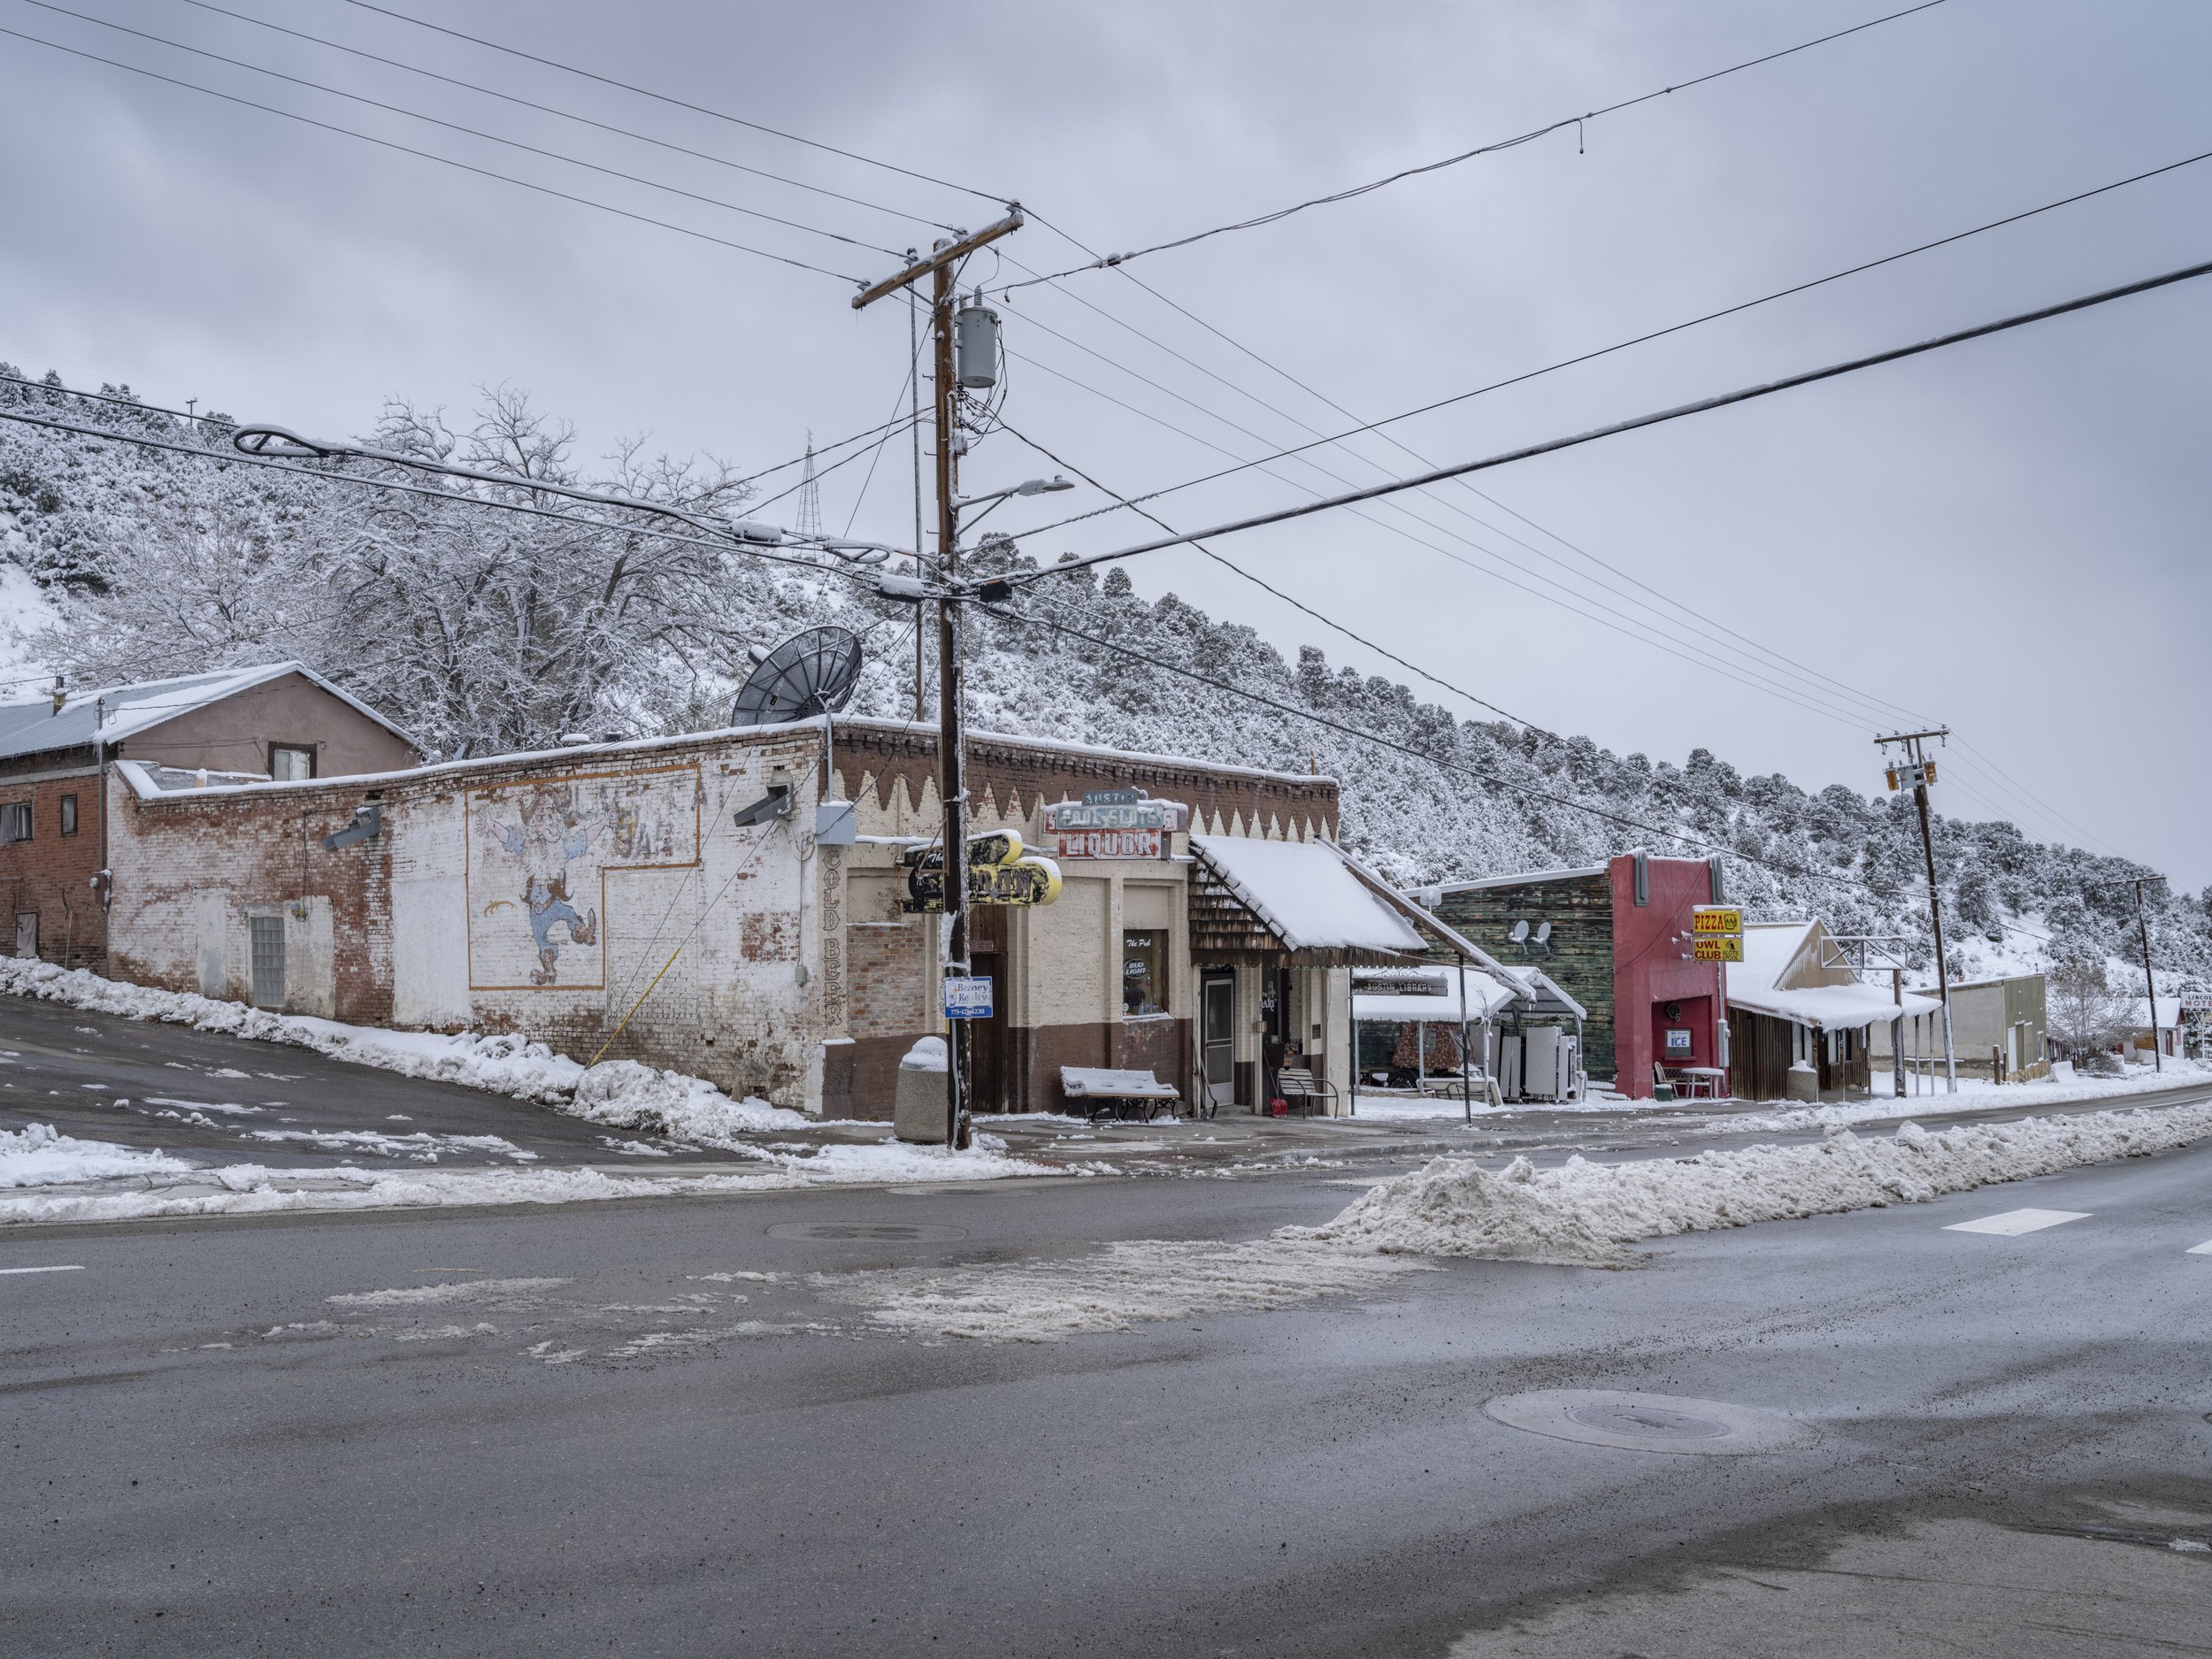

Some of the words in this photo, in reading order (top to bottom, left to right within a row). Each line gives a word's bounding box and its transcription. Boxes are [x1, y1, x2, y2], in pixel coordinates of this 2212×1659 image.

[1065, 833, 1152, 860] LIQUOR
[823, 849, 841, 932] COLD
[1694, 915, 1724, 929] PIZZA
[1126, 939, 1138, 948] The
[1696, 940, 1720, 949] OWL
[1694, 950, 1721, 959] CLUB
[823, 938, 841, 1026] BEER
[1399, 983, 1432, 992] LIBRARY
[1671, 1036, 1686, 1046] ICE
